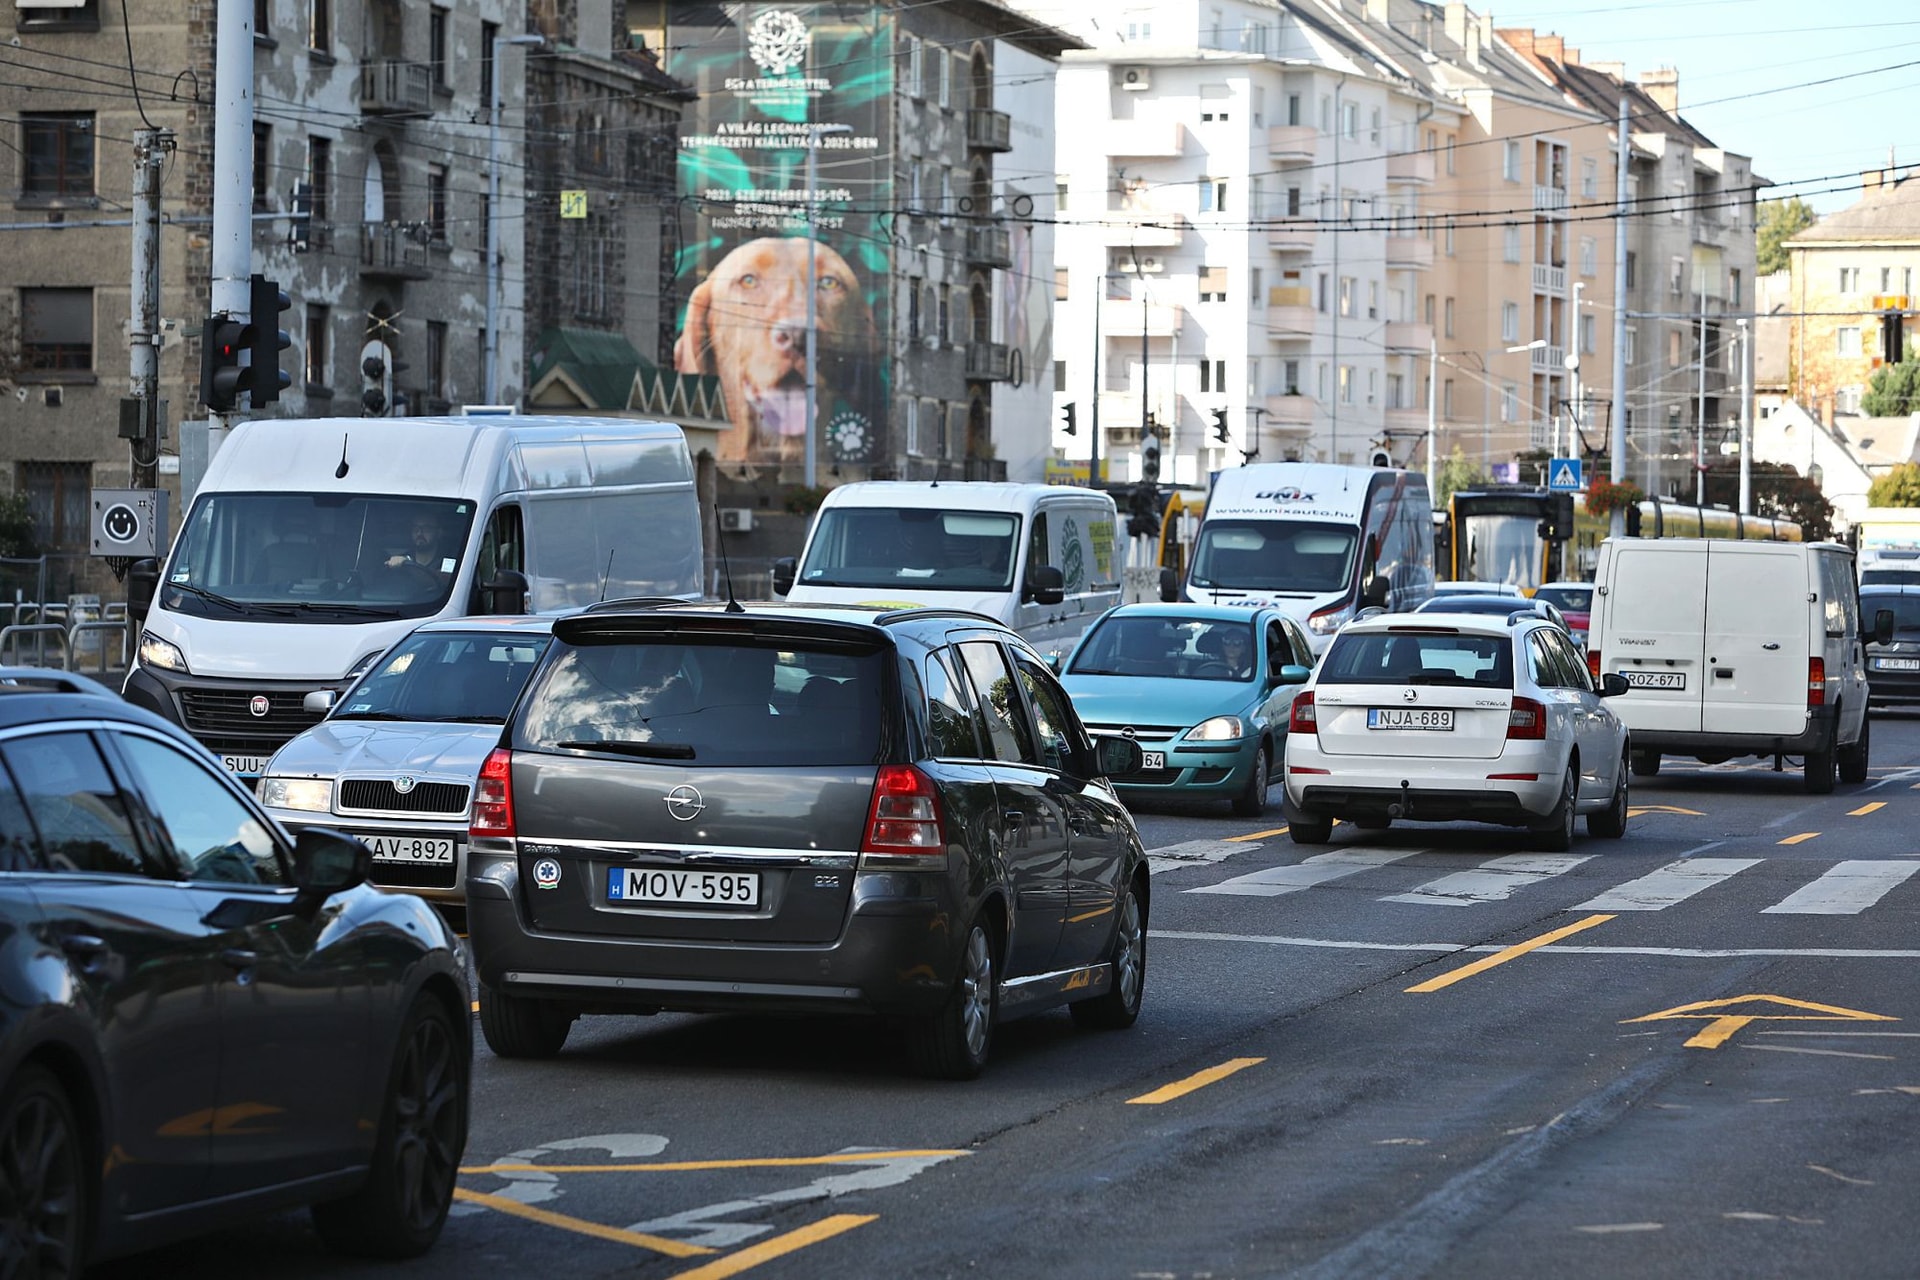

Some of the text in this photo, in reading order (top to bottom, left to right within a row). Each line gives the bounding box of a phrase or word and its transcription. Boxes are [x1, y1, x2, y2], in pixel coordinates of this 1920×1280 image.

[716, 123, 727, 134] A
[728, 121, 762, 135] VILÁG
[680, 135, 753, 148] TERMÉSZETI
[824, 137, 879, 149] 2021-BEN
[735, 189, 811, 201] SZEPTEMBER
[1215, 508, 1354, 519] www.unixauto.hu
[1628, 673, 1681, 687] ROZ-671
[1380, 711, 1450, 726] NJA-689
[612, 871, 752, 901] H MOV-595
